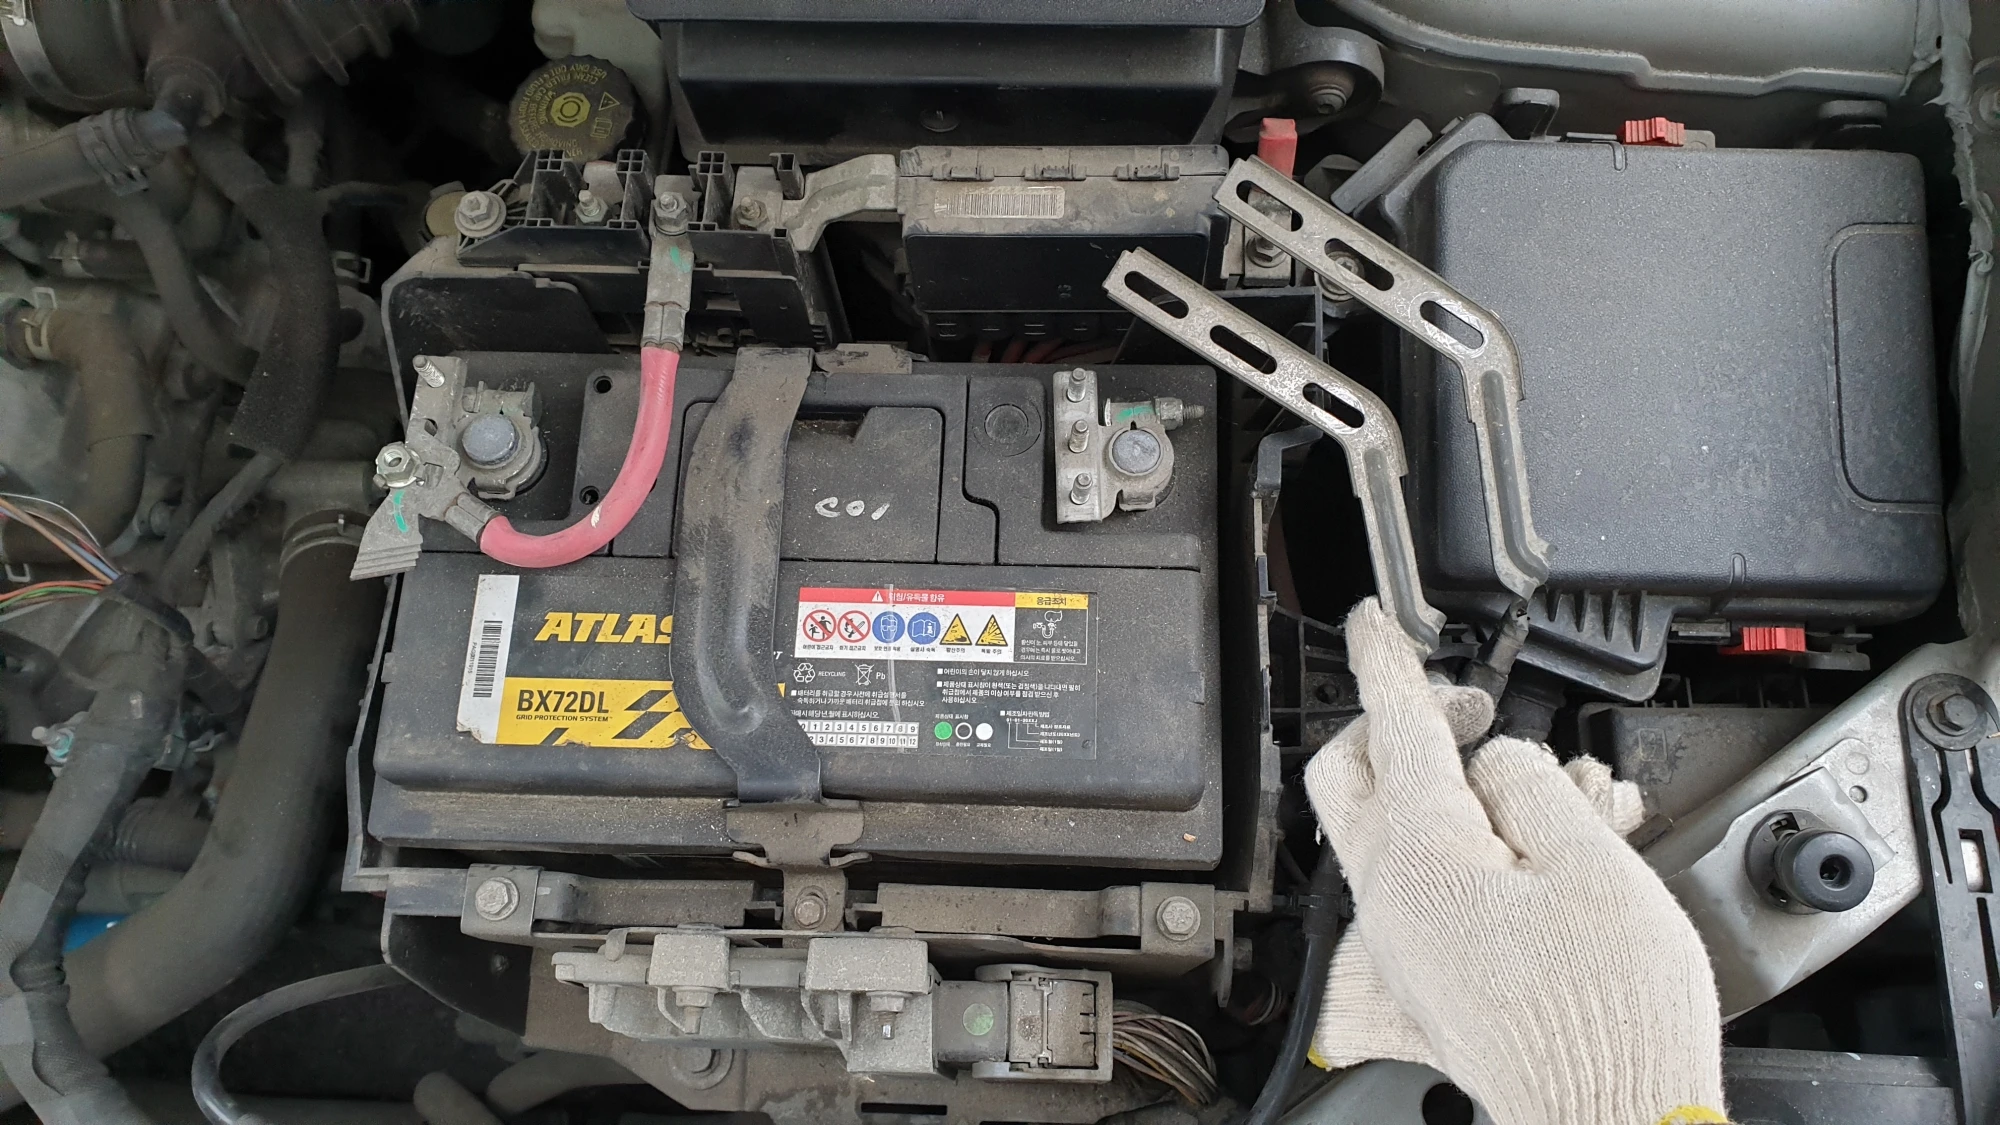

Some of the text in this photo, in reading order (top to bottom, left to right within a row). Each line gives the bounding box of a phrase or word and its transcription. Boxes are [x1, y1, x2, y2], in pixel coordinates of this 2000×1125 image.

[551, 65, 567, 76] DOT
[574, 72, 598, 85] CLEAN
[592, 65, 607, 79] USE
[526, 76, 544, 96] FLUID
[547, 73, 571, 89] FILLER
[535, 86, 547, 102] CAP
[518, 97, 530, 119] FROM
[538, 90, 556, 125] WARNING
[527, 103, 540, 132] BEFORE
[930, 593, 945, 602] 함유
[1037, 597, 1067, 606] 응급조치
[876, 672, 886, 680] Pb
[517, 689, 609, 714] BX72DL
